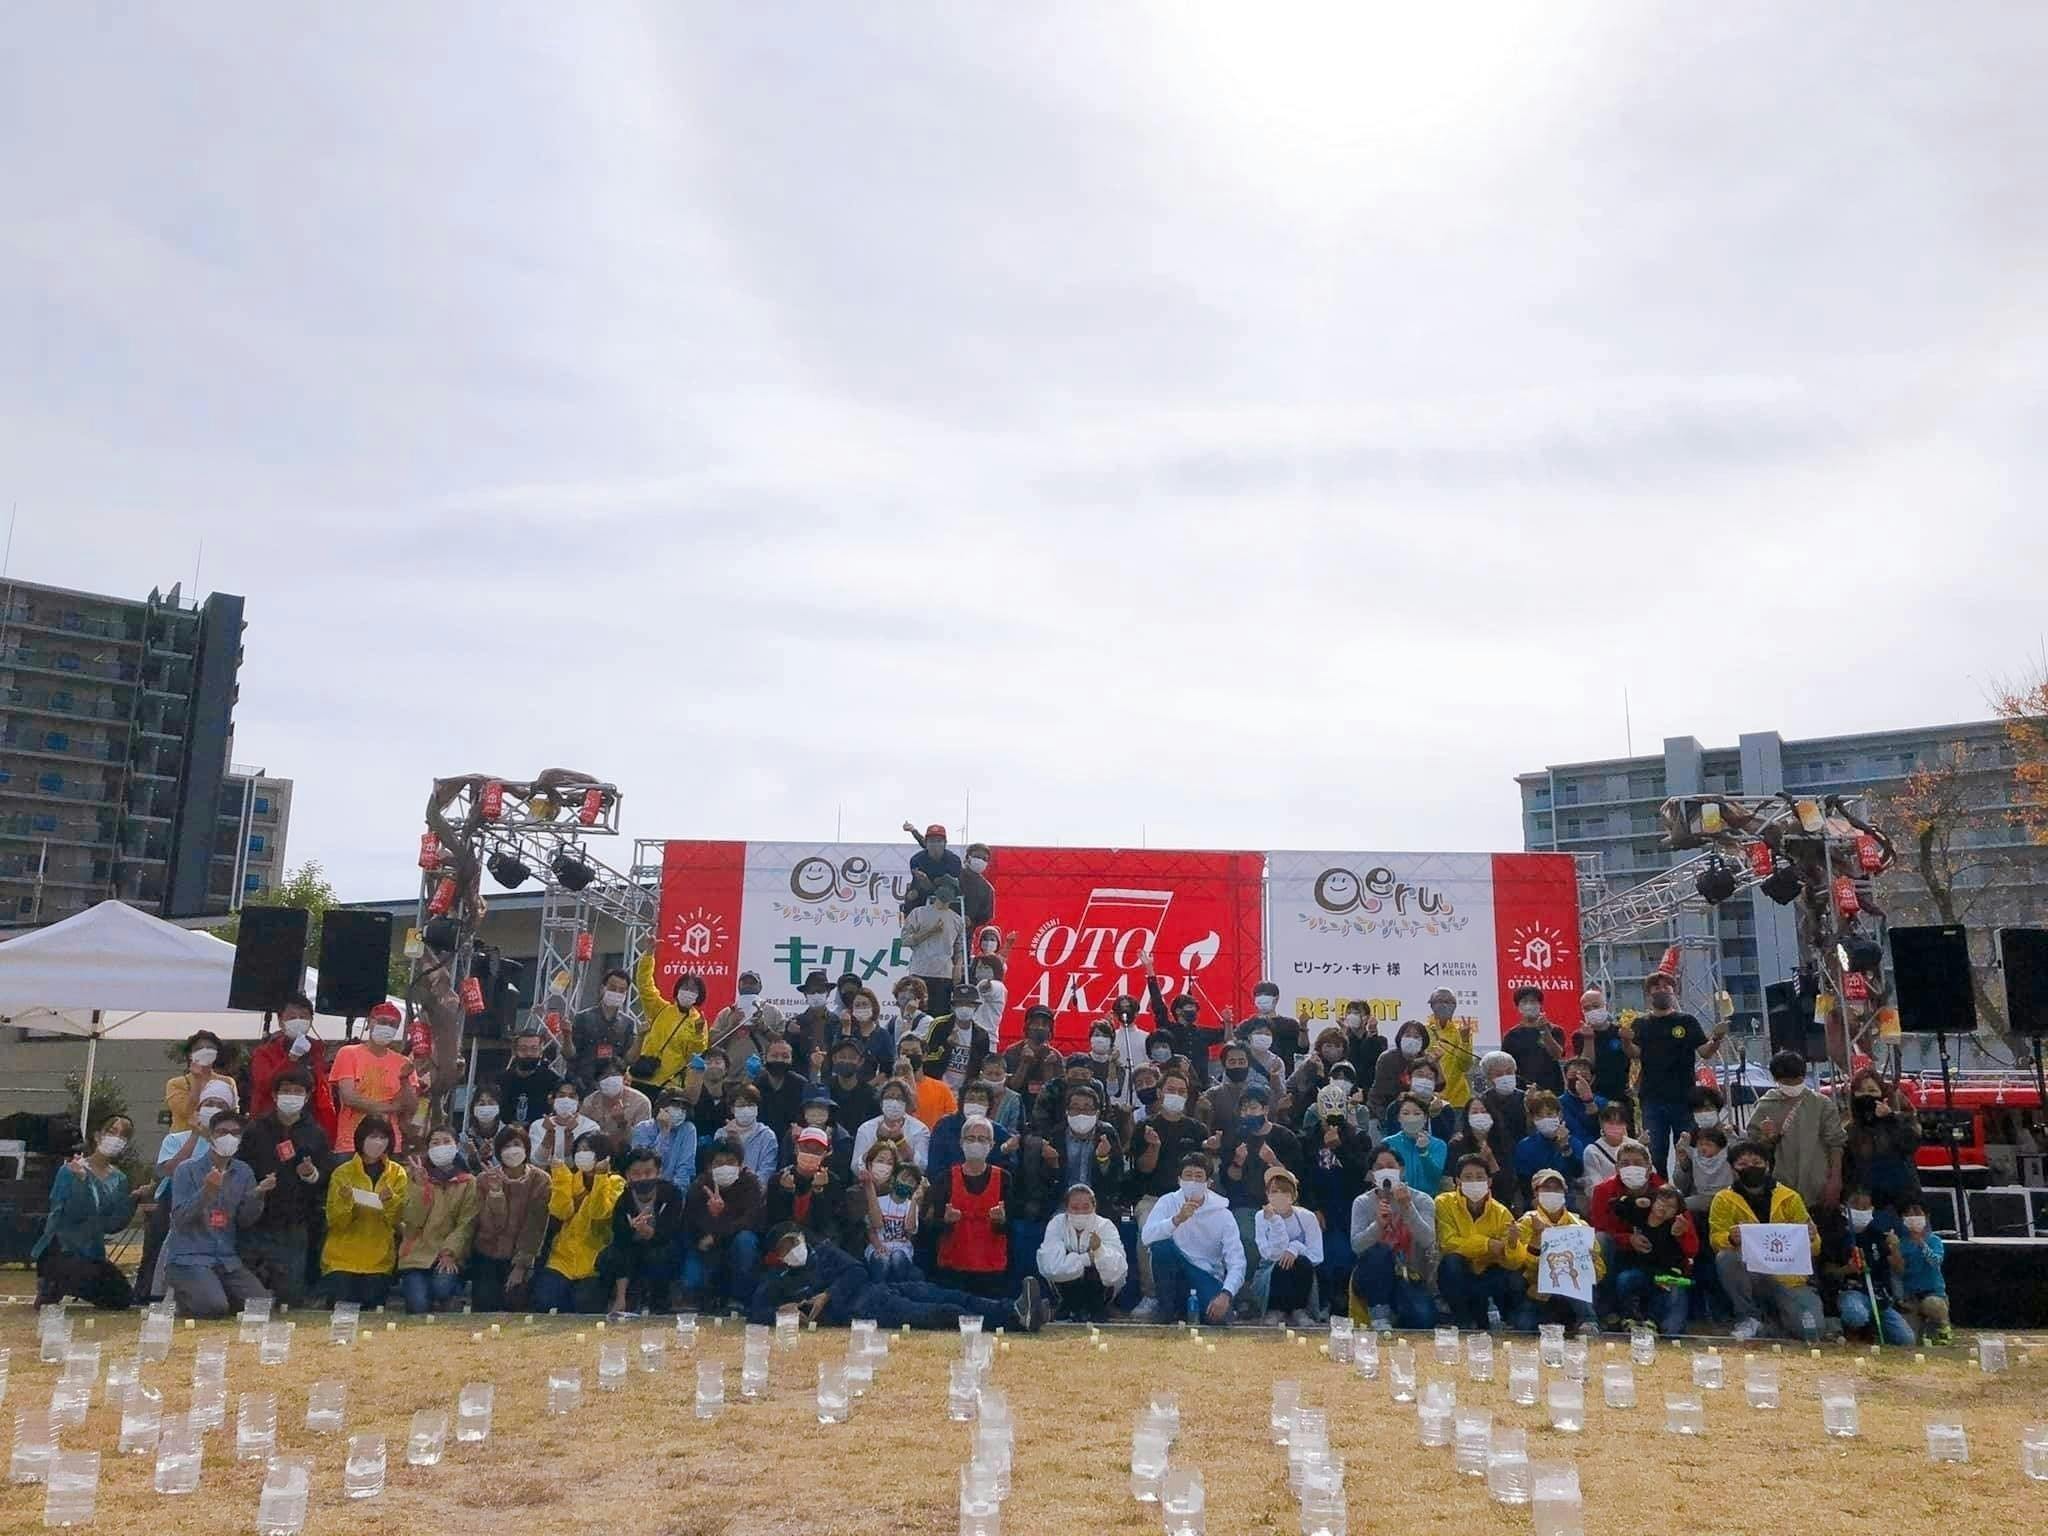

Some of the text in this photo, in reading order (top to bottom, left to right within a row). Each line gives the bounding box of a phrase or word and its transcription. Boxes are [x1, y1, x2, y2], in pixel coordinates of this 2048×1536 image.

[1029, 918, 1060, 956] KAWANISHI
[1036, 926, 1155, 969] OTO
[664, 965, 728, 975] OTOAKARI
[1387, 961, 1401, 976] 様
[1508, 980, 1573, 990] OTOAKARI
